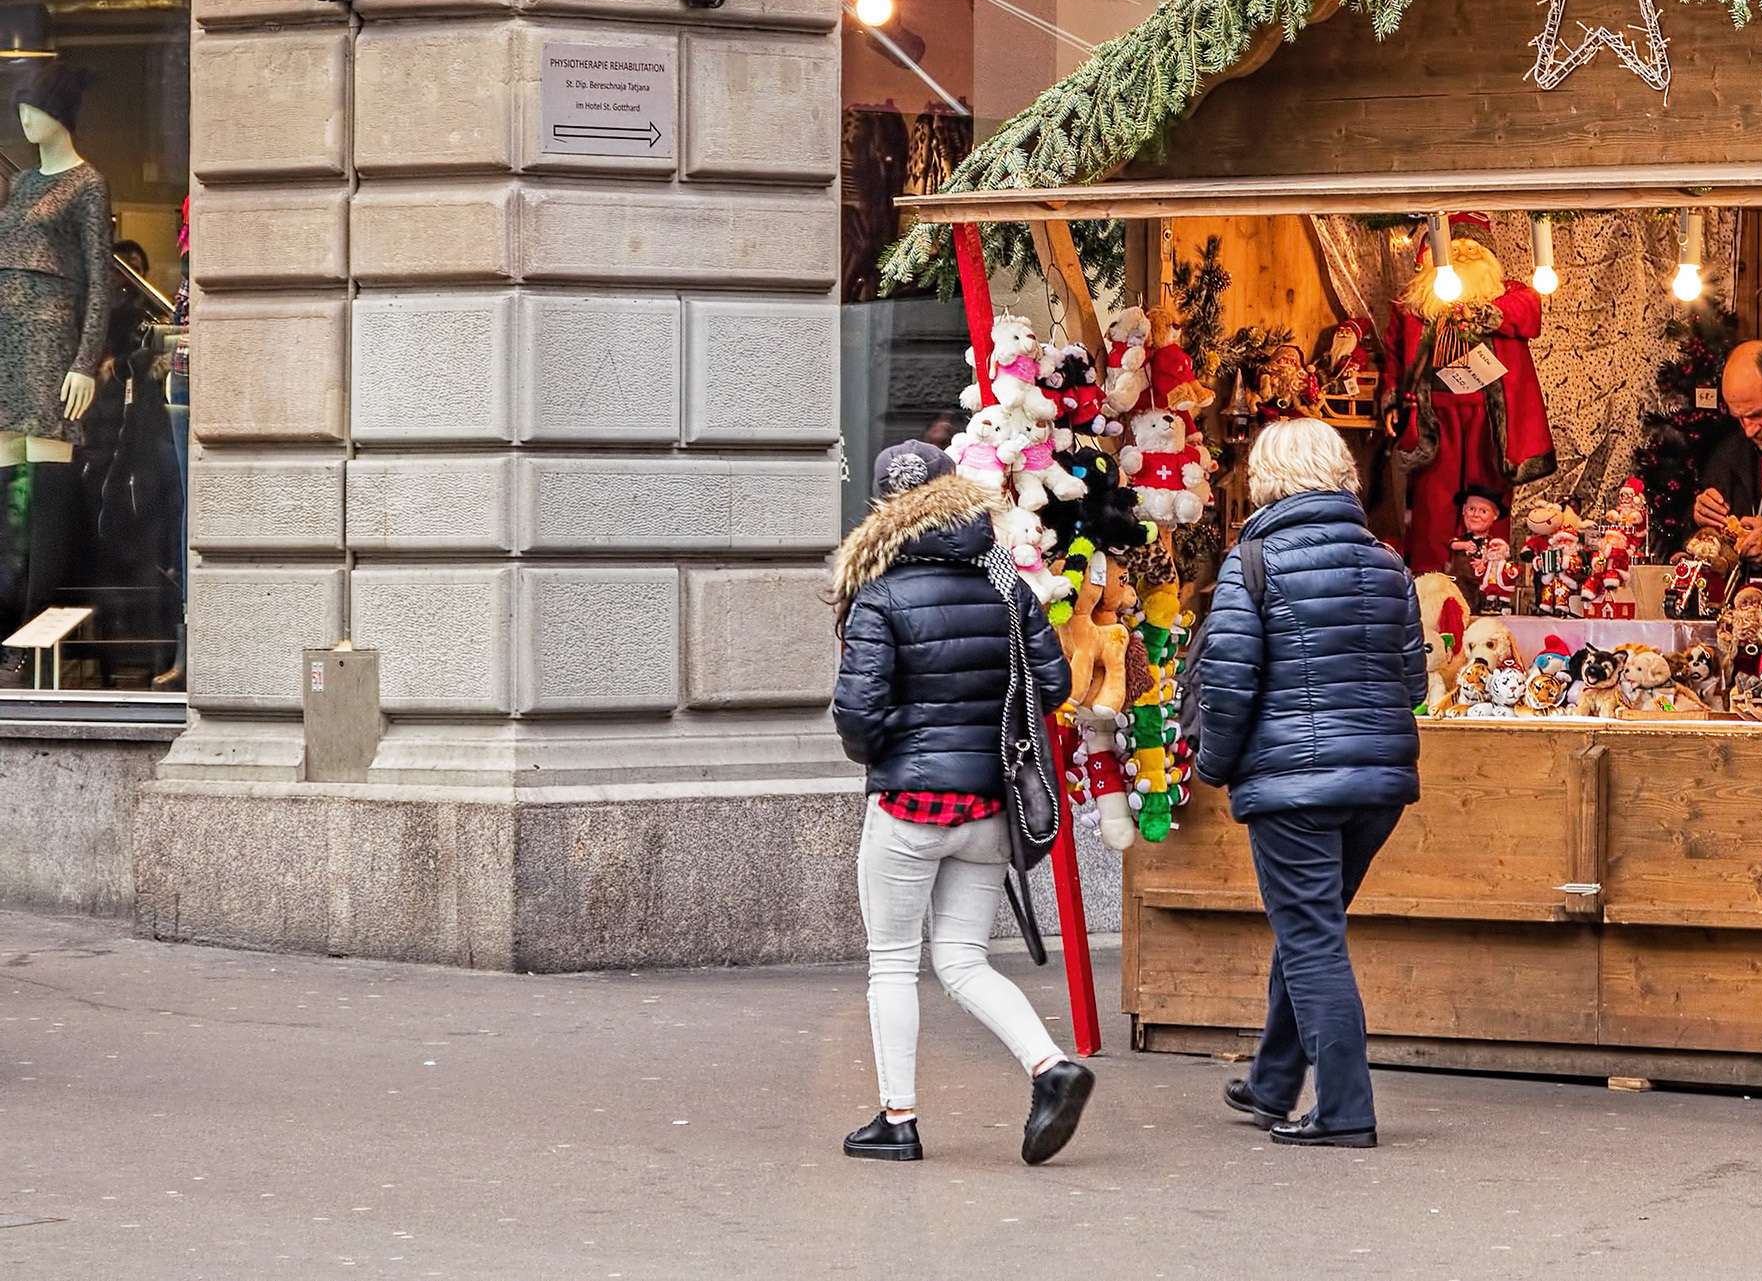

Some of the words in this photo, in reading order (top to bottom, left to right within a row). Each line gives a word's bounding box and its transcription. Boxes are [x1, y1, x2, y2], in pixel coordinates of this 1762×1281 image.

[550, 58, 608, 70] PHYSIOTHERAPIE
[609, 60, 665, 73] REHABILITATION
[585, 102, 602, 111] Hotel
[612, 103, 641, 112] Gotthard
